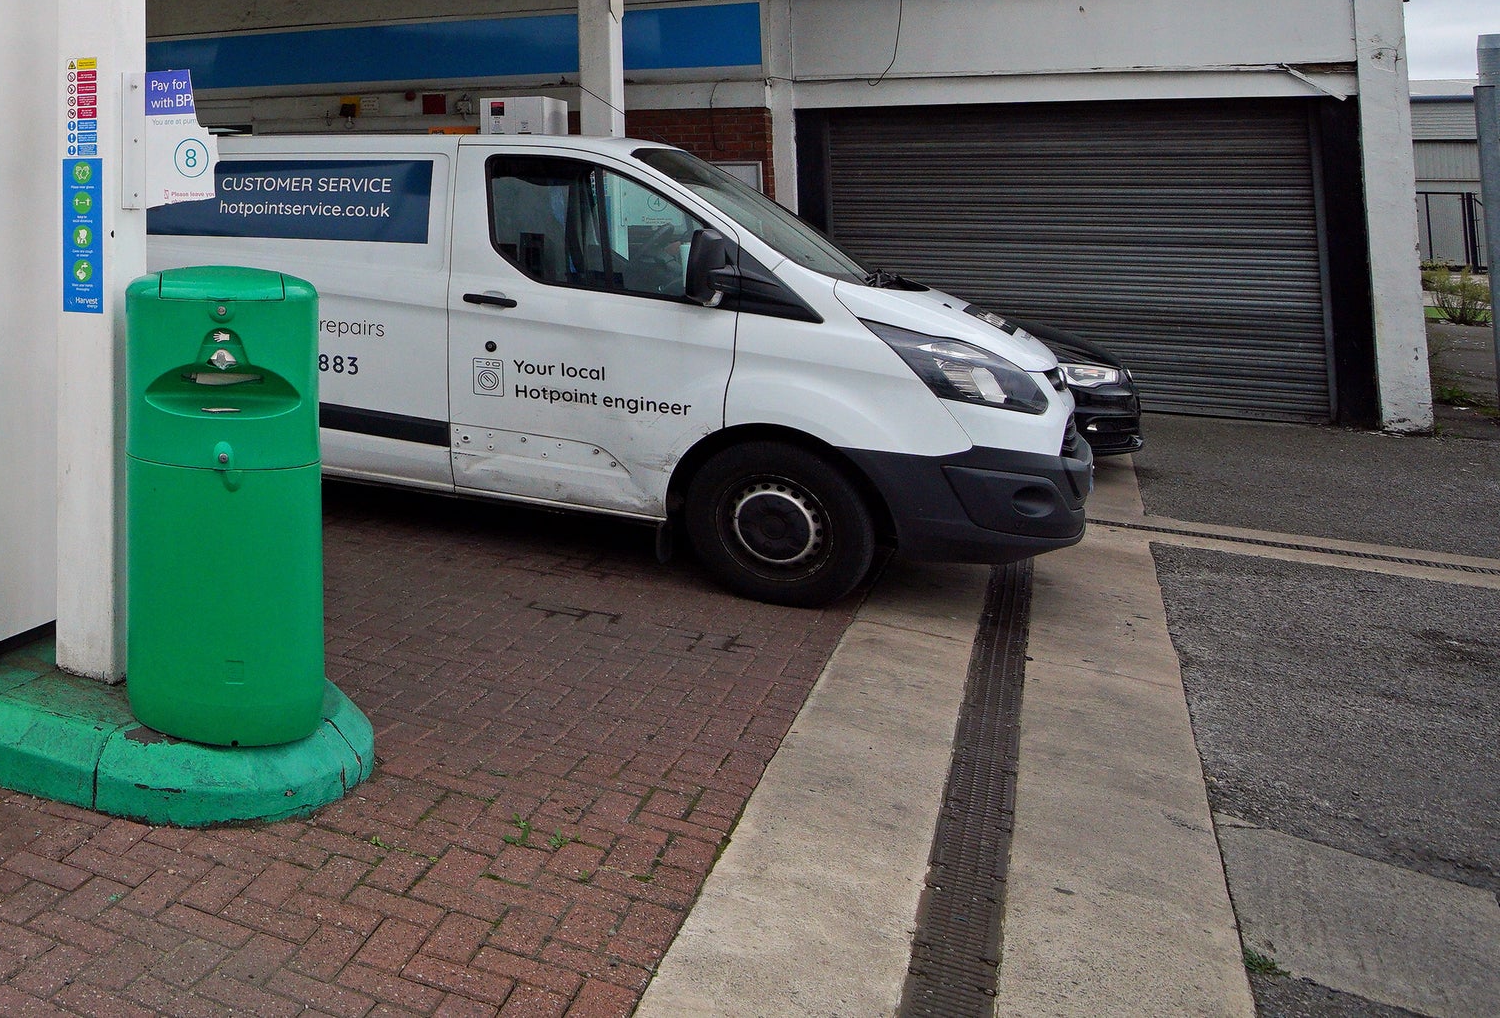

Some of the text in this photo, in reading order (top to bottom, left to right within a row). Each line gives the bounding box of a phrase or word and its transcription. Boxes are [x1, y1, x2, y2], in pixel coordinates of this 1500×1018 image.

[151, 78, 188, 92] Pay for
[150, 98, 174, 109] with
[152, 118, 163, 126] You
[185, 148, 197, 168] 8
[222, 176, 392, 194] CUSTOMER SERVICE
[219, 200, 390, 218] hotpointservice.co.uk
[320, 320, 385, 338] repairs
[318, 354, 358, 375] 883
[513, 359, 605, 381] Your local
[515, 384, 692, 416] Hotpoint engineer
